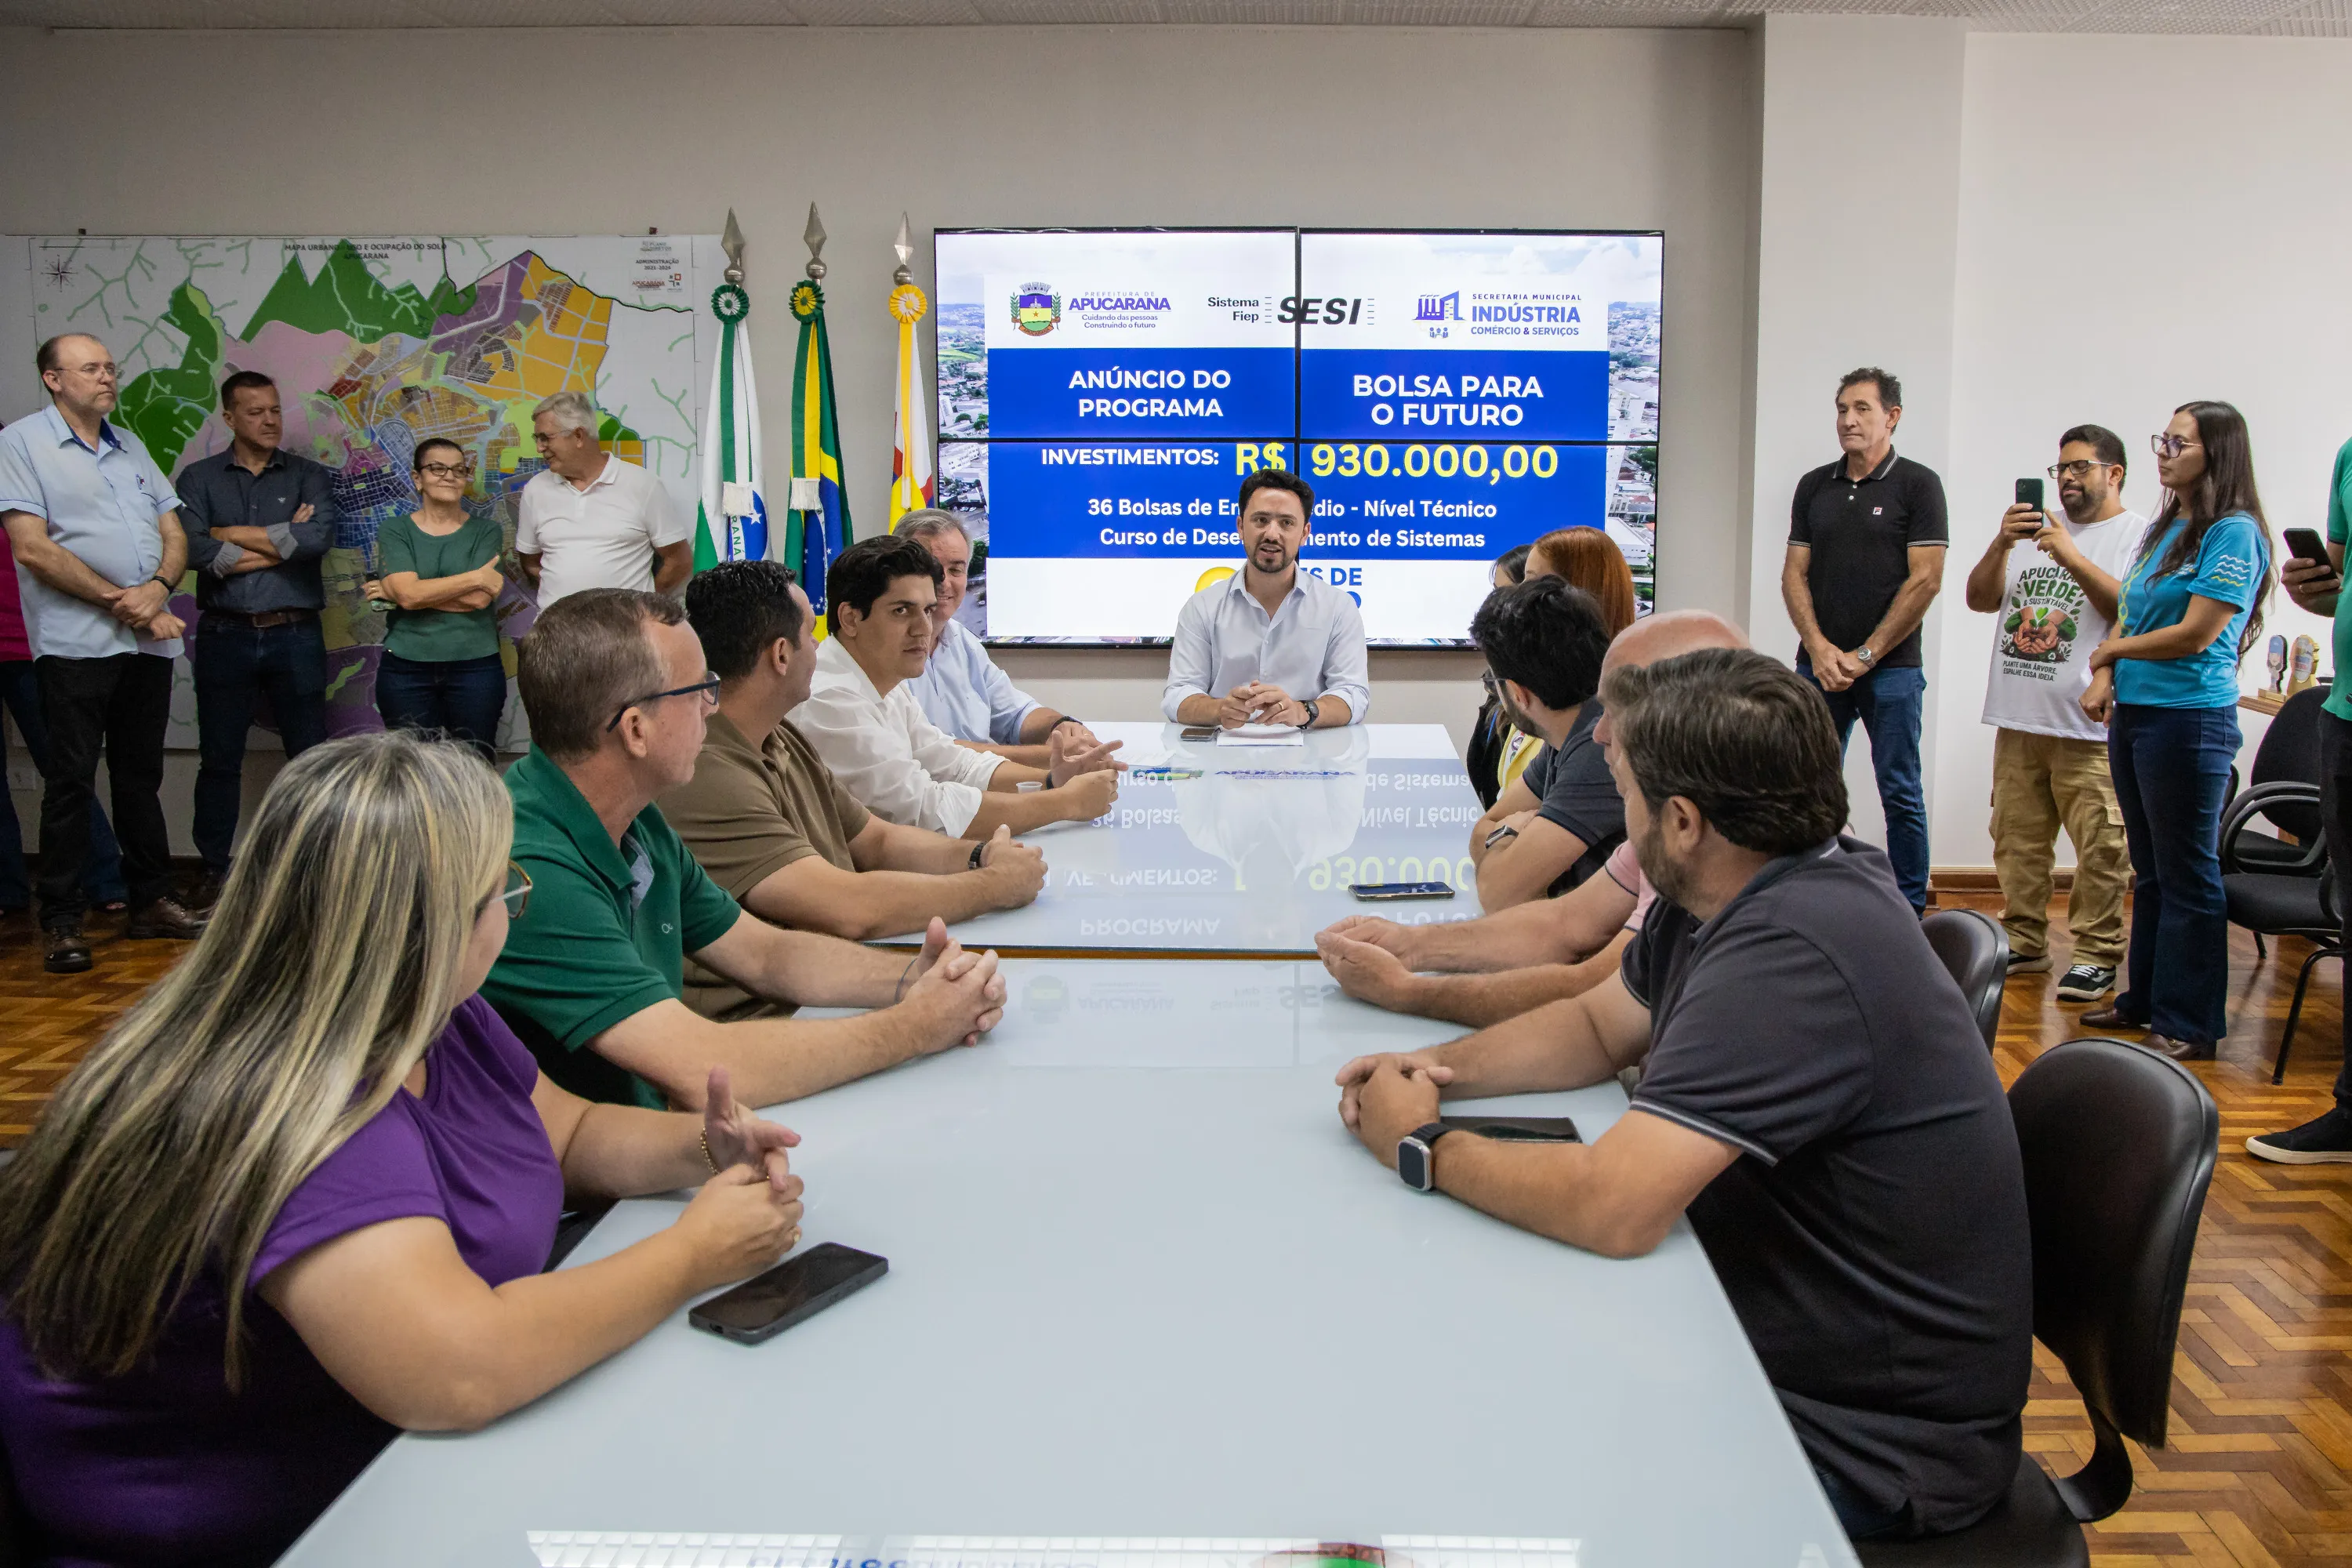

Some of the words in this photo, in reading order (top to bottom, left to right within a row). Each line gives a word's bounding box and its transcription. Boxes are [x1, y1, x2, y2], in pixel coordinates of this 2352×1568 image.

[371, 242, 412, 252] OCUPAÇÃO
[1069, 297, 1171, 310] APUCARANA
[1207, 296, 1259, 307] Sistema
[1277, 296, 1362, 325] SESI
[1232, 311, 1259, 323] Fiep
[1472, 303, 1581, 323] INDÚSTRIA
[1471, 325, 1521, 335] COMÉRCIO
[1532, 327, 1580, 337] SERVIÇOS
[1069, 366, 1186, 389] ANÚNCIO
[1193, 370, 1232, 389] DO
[1353, 375, 1454, 397] BOLSA
[1461, 376, 1544, 398] PARA
[1079, 398, 1225, 417] PROGRAMA
[1371, 403, 1394, 425] O
[1403, 404, 1524, 426] FUTURO
[1041, 448, 1219, 465] INVESTIMENTOS:
[1236, 442, 1287, 475] R$
[1311, 444, 1558, 485] 930.000,00
[1088, 499, 1113, 516] 36
[1119, 499, 1182, 516] Bolsas
[1188, 499, 1212, 516] de
[1364, 499, 1415, 517] Nível
[1420, 500, 1497, 517] Técnico
[1101, 528, 1157, 545] Curso
[1163, 528, 1187, 545] de
[1367, 529, 1392, 546] de
[1396, 529, 1486, 547] Sistemas
[1330, 568, 1363, 586] DE
[2024, 579, 2082, 604] VERDE
